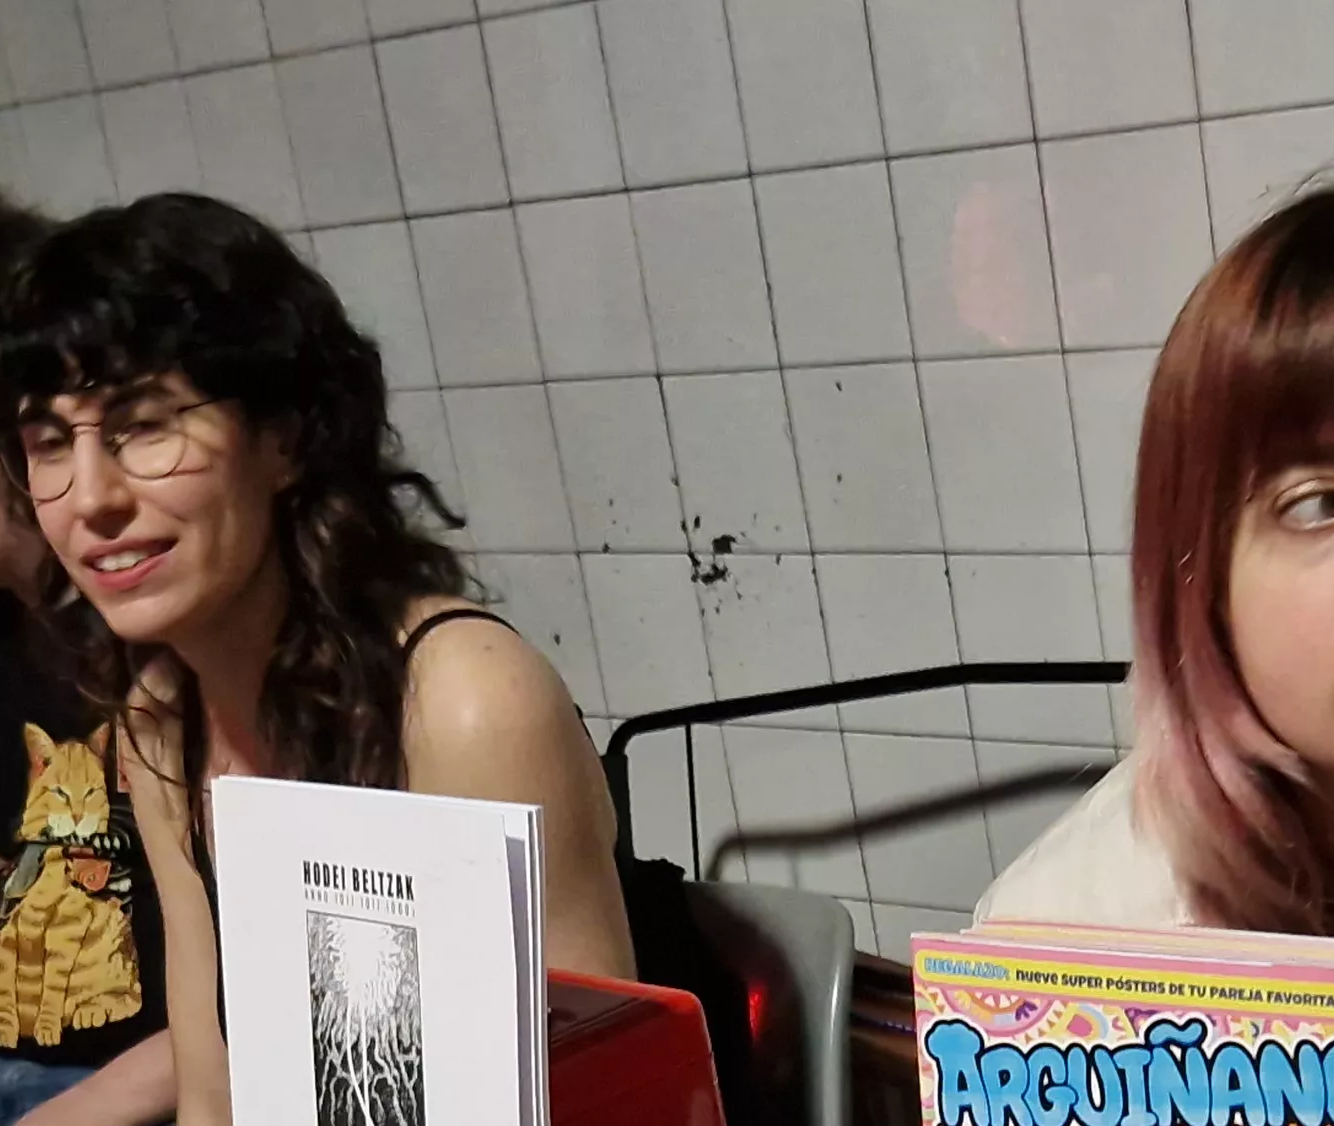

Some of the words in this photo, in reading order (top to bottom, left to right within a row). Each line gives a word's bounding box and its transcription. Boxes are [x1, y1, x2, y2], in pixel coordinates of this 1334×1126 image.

[302, 860, 346, 891] HODEI
[352, 867, 415, 901] BELTZAK
[1061, 974, 1103, 991] SUPER
[1106, 975, 1166, 995] PÓSTERS
[1169, 983, 1185, 997] DE
[1188, 984, 1207, 998] TU
[1210, 986, 1264, 1004] PAREJA
